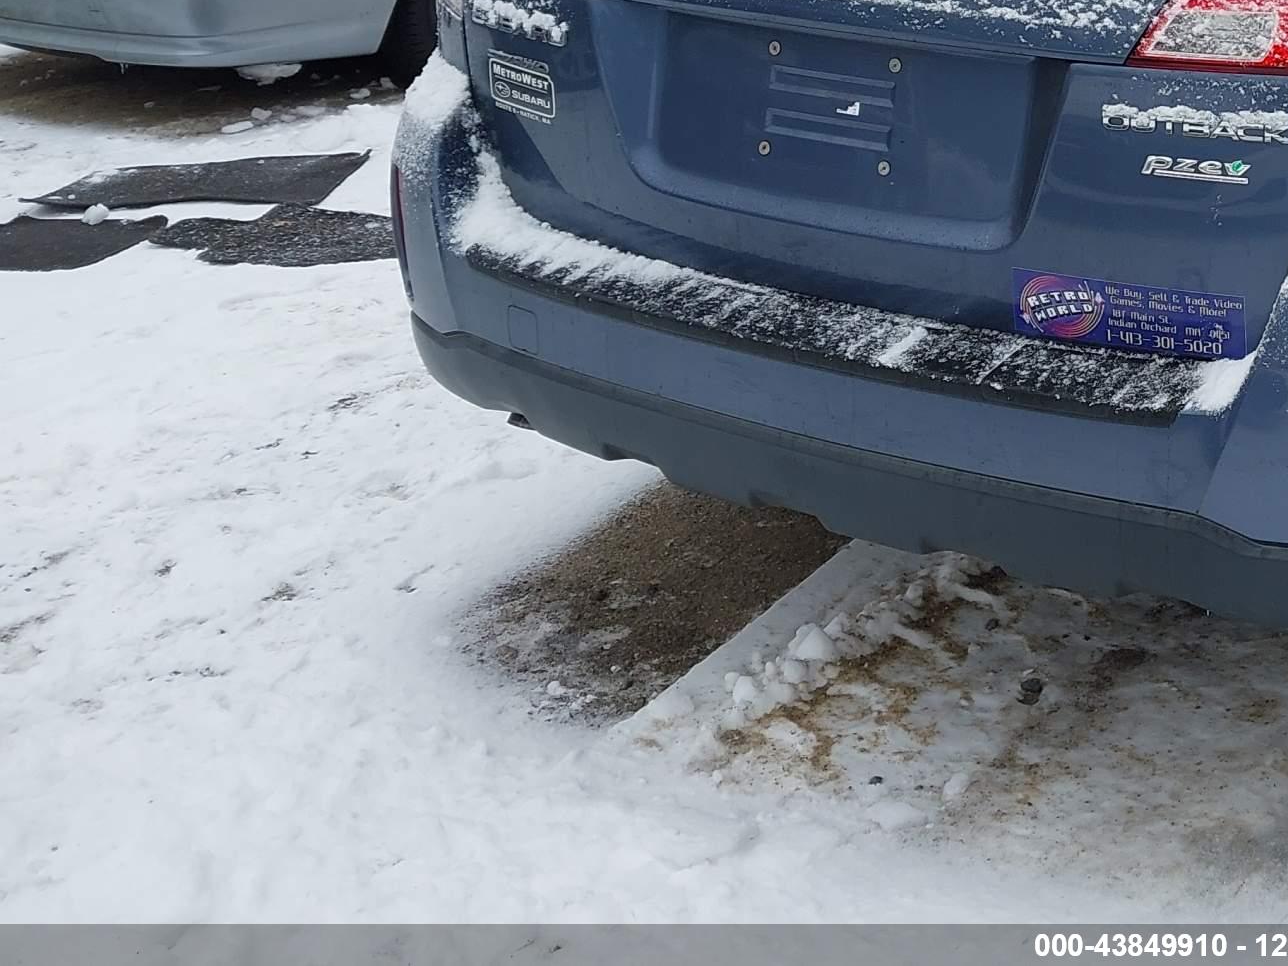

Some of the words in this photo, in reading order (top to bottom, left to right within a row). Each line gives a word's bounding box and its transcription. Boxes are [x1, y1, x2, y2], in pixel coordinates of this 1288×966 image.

[511, 89, 550, 109] SUBARU
[1026, 290, 1090, 308] RETRO
[1105, 285, 1120, 295] We
[1148, 291, 1168, 302] Sell
[1172, 294, 1180, 303] &
[1184, 295, 1210, 307] Trade
[1213, 298, 1242, 309] Video
[1035, 303, 1093, 322] WORLD
[1148, 300, 1184, 313] Movies
[1188, 305, 1196, 314] &
[1108, 317, 1137, 329] Indian
[1140, 321, 1177, 334] Orchard
[1130, 311, 1155, 323] Main
[1107, 328, 1223, 355] 1-413-301-5020
